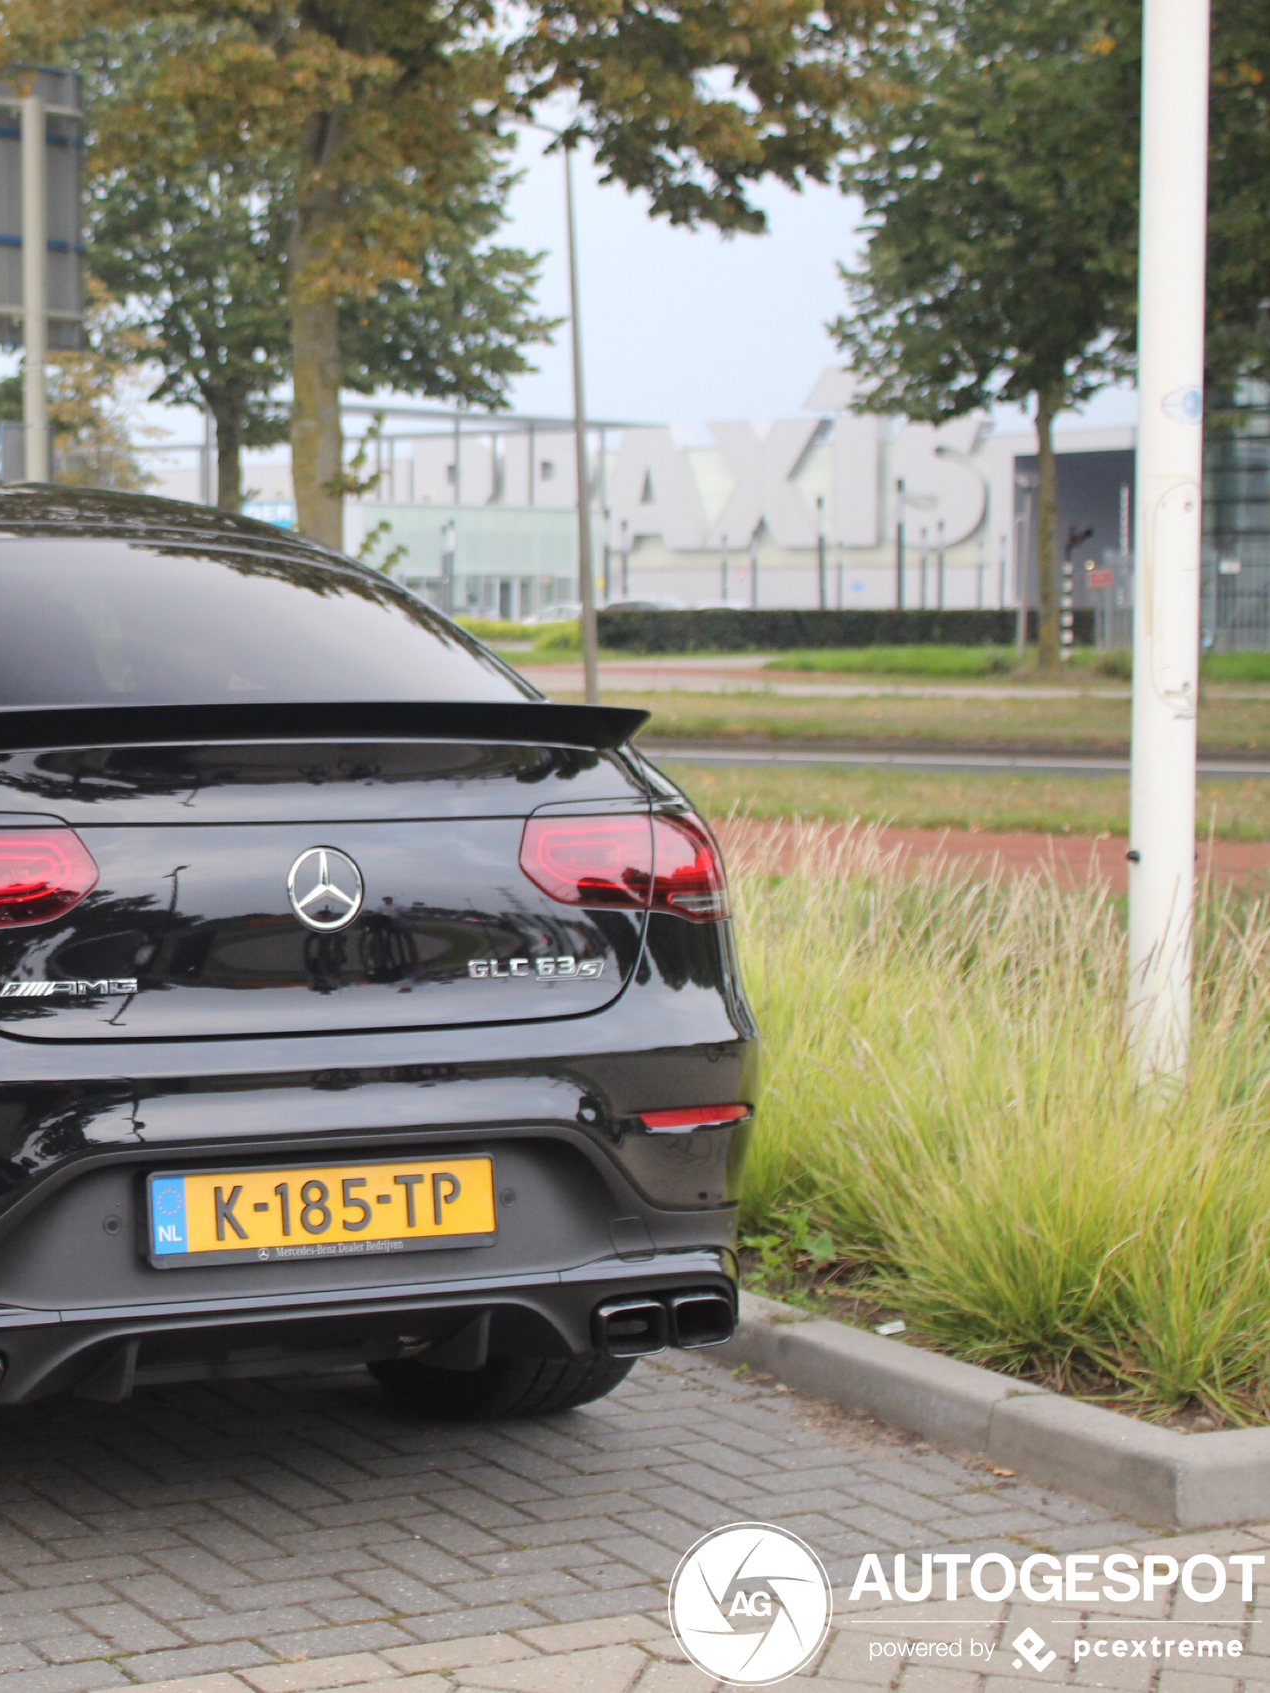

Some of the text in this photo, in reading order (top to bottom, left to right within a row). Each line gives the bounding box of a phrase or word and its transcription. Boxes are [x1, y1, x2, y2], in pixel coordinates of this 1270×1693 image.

[467, 957, 529, 979] GLC
[214, 1172, 462, 1242] K-185-TP
[158, 1224, 182, 1243] NL
[276, 1240, 404, 1258] Mercedes-Benz Dealer Bedrijven
